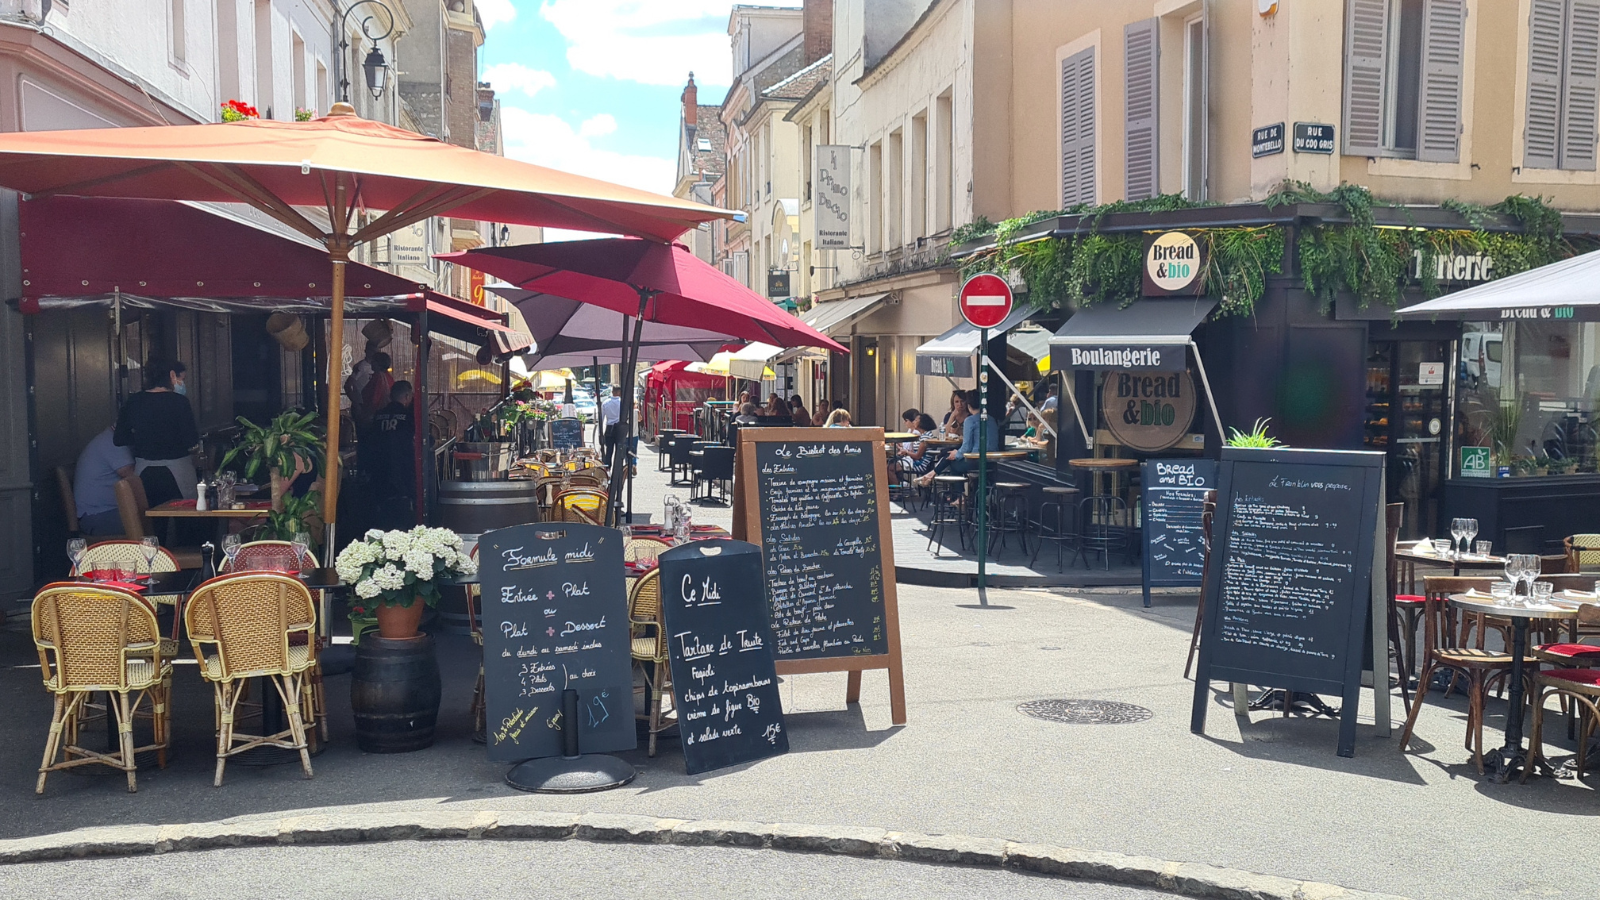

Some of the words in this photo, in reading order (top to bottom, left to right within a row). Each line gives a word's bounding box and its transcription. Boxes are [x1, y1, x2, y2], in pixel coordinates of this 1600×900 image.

[1258, 130, 1267, 140] RUE
[1270, 128, 1277, 137] DE
[1308, 127, 1322, 136] RUE
[1253, 139, 1281, 153] MONTEBELLO
[1297, 138, 1304, 147] DU
[1306, 139, 1317, 149] COQ
[1319, 140, 1333, 149] GRIS
[1152, 242, 1194, 261] Bread
[1072, 348, 1161, 367] Boulangerie
[1117, 373, 1180, 398] Bread
[775, 444, 792, 457] Le
[796, 445, 825, 458] Bistrot
[828, 446, 840, 454] des
[844, 445, 861, 454] Amis
[1464, 454, 1485, 469] AB
[1159, 476, 1175, 484] and
[1179, 475, 1205, 486] BIO
[502, 546, 558, 571] Formule
[565, 542, 594, 559] midi
[501, 585, 538, 603] Entrée
[546, 590, 555, 600] +
[562, 581, 590, 598] Plat
[682, 574, 696, 602] Ce
[701, 576, 721, 601] Midi
[501, 621, 528, 639] Plat
[546, 627, 555, 636] +
[560, 615, 606, 637] Dessert
[502, 648, 511, 657] du
[674, 631, 715, 657] Tartare
[719, 634, 732, 652] de
[518, 663, 528, 676] 3
[530, 661, 556, 674] Entrées
[685, 689, 705, 706] chips
[708, 685, 718, 697] de
[687, 710, 706, 721] crème
[711, 704, 720, 715] de
[687, 732, 695, 745] et
[699, 727, 719, 742] salade
[722, 724, 742, 737] verte
